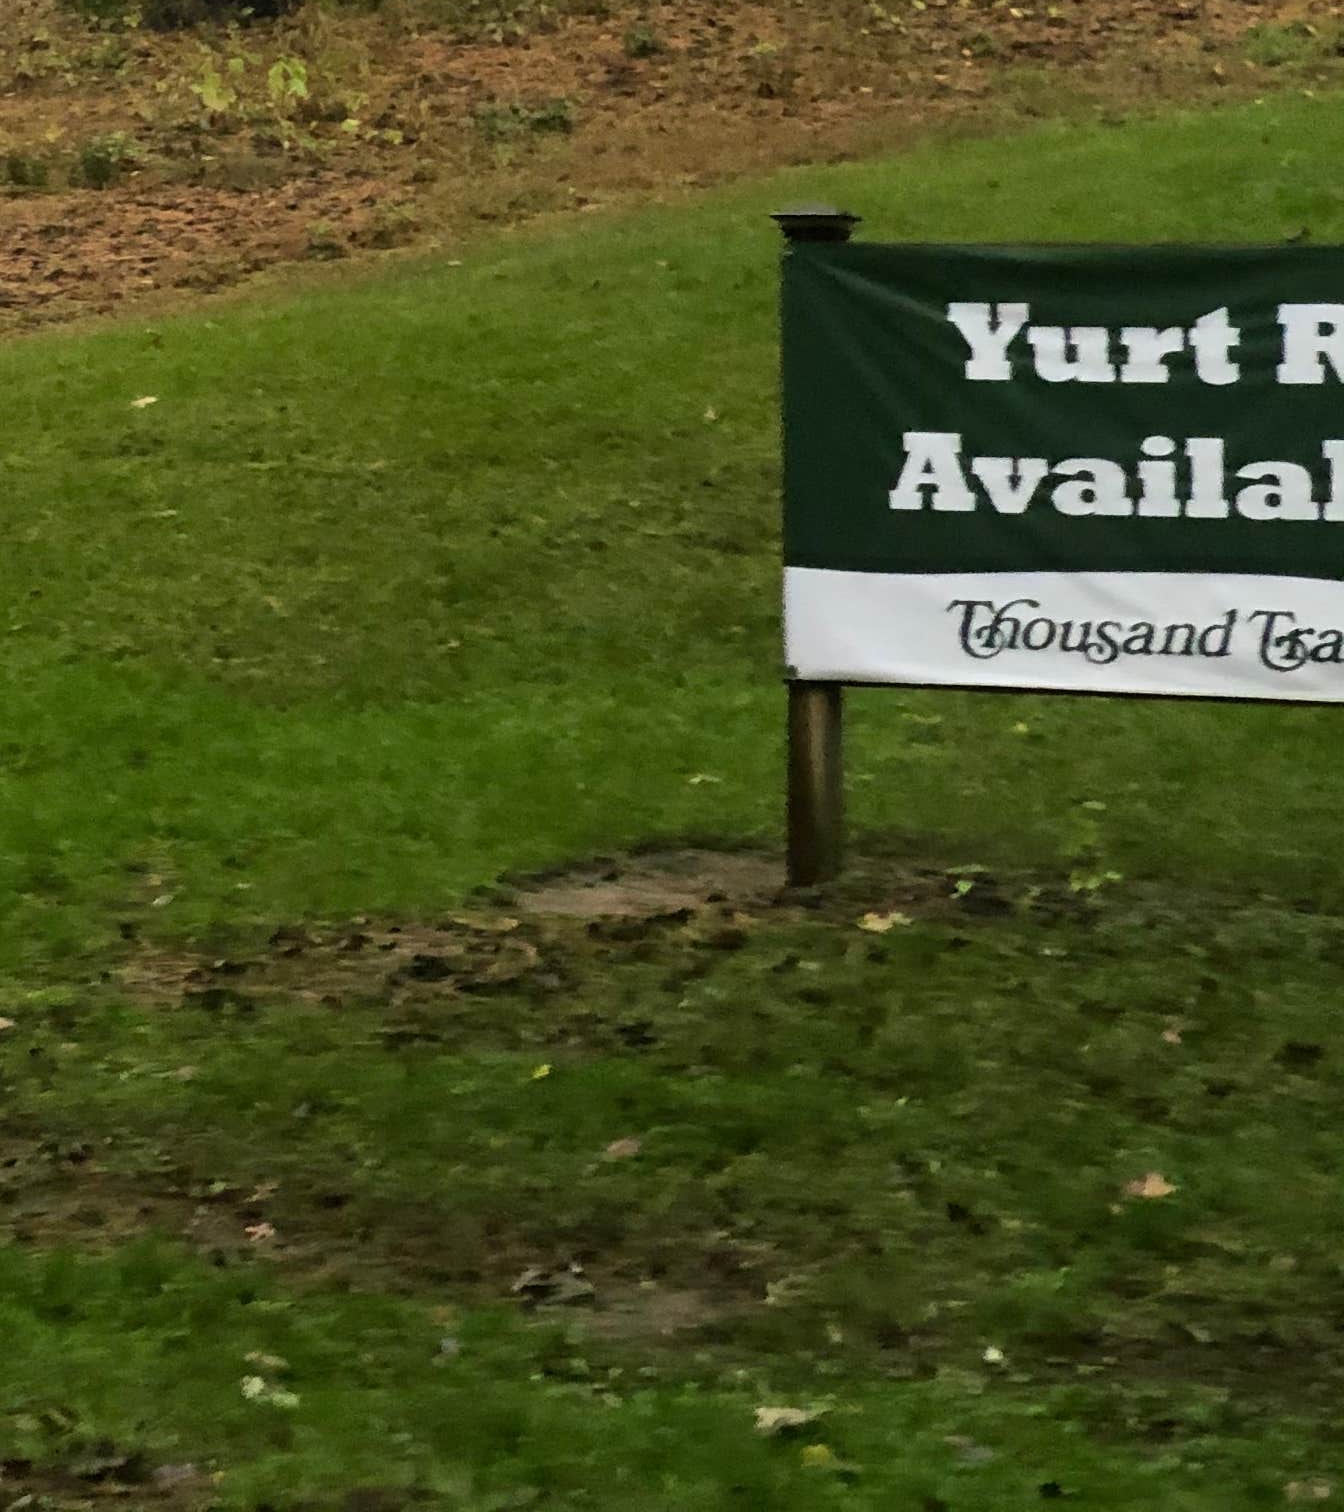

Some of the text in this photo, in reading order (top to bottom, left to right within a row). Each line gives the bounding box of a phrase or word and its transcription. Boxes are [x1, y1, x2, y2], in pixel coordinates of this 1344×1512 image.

[946, 302, 1241, 385] Yurt
[888, 431, 1344, 522] Availa
[946, 599, 1344, 672] Thousand Tra
